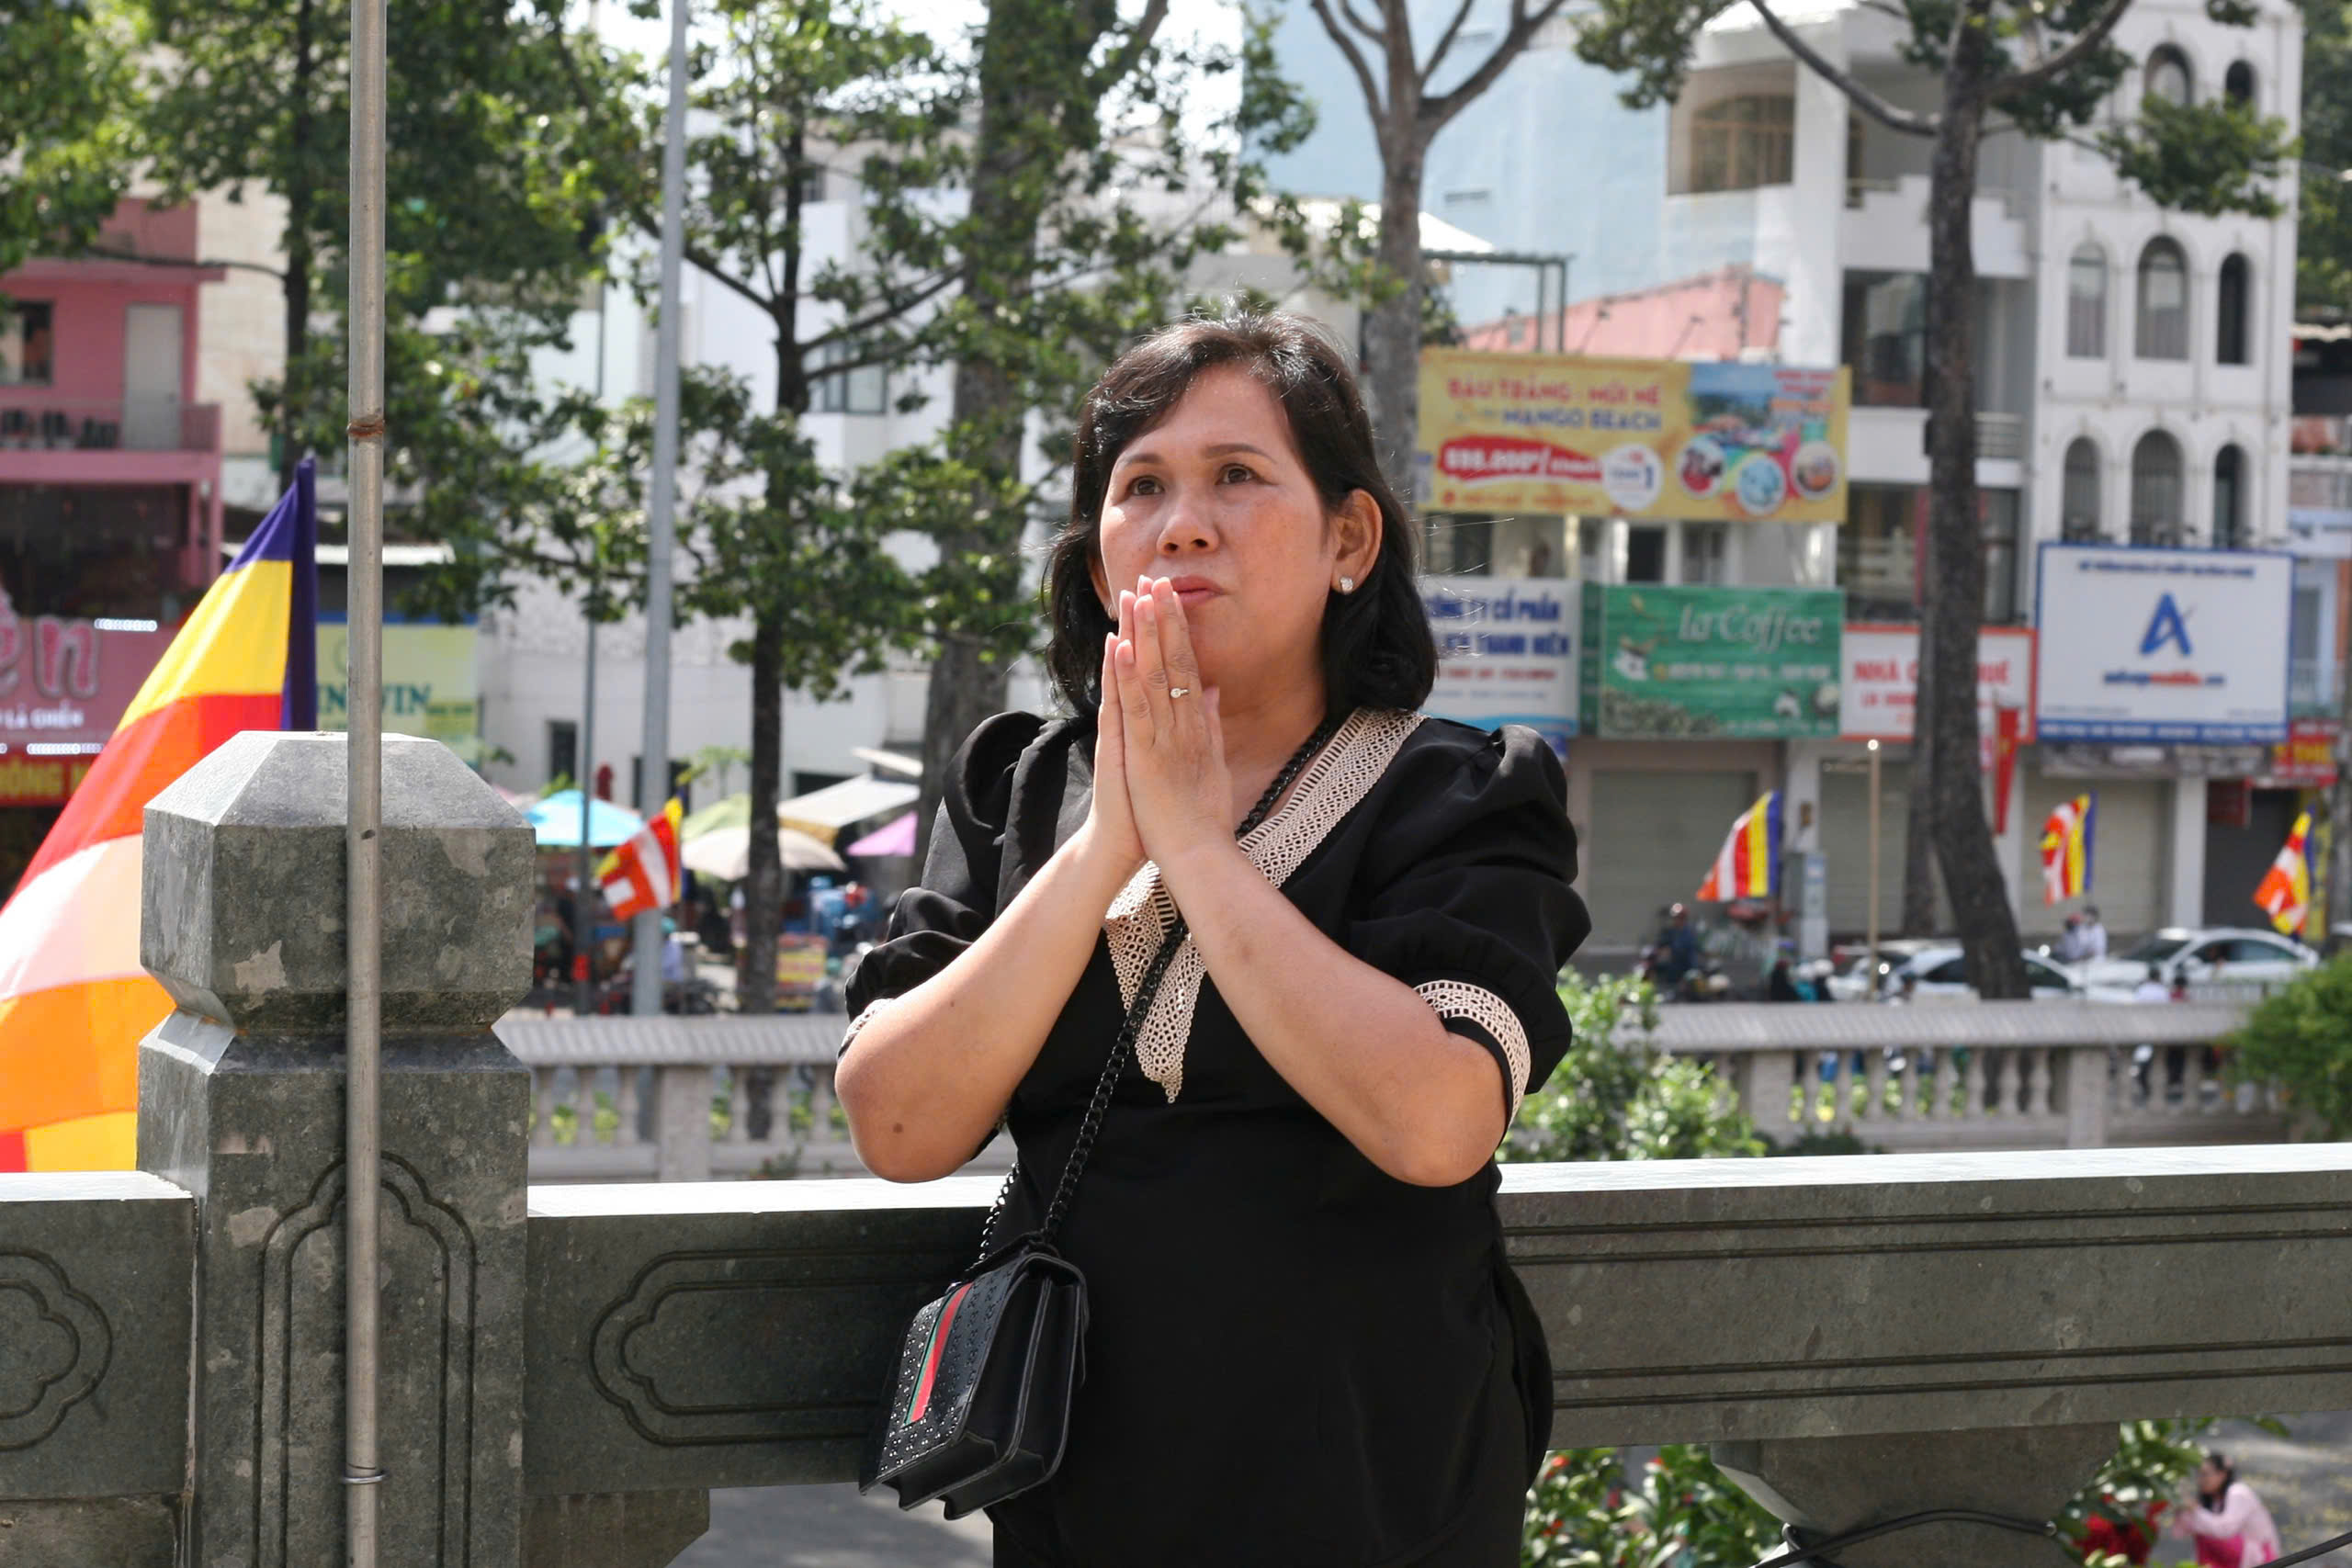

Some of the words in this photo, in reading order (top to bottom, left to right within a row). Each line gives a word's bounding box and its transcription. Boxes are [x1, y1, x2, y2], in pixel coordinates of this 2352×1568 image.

[1503, 408, 1585, 428] MANGO
[1590, 409, 1663, 431] BEACH
[1719, 604, 1824, 653] Coffee
